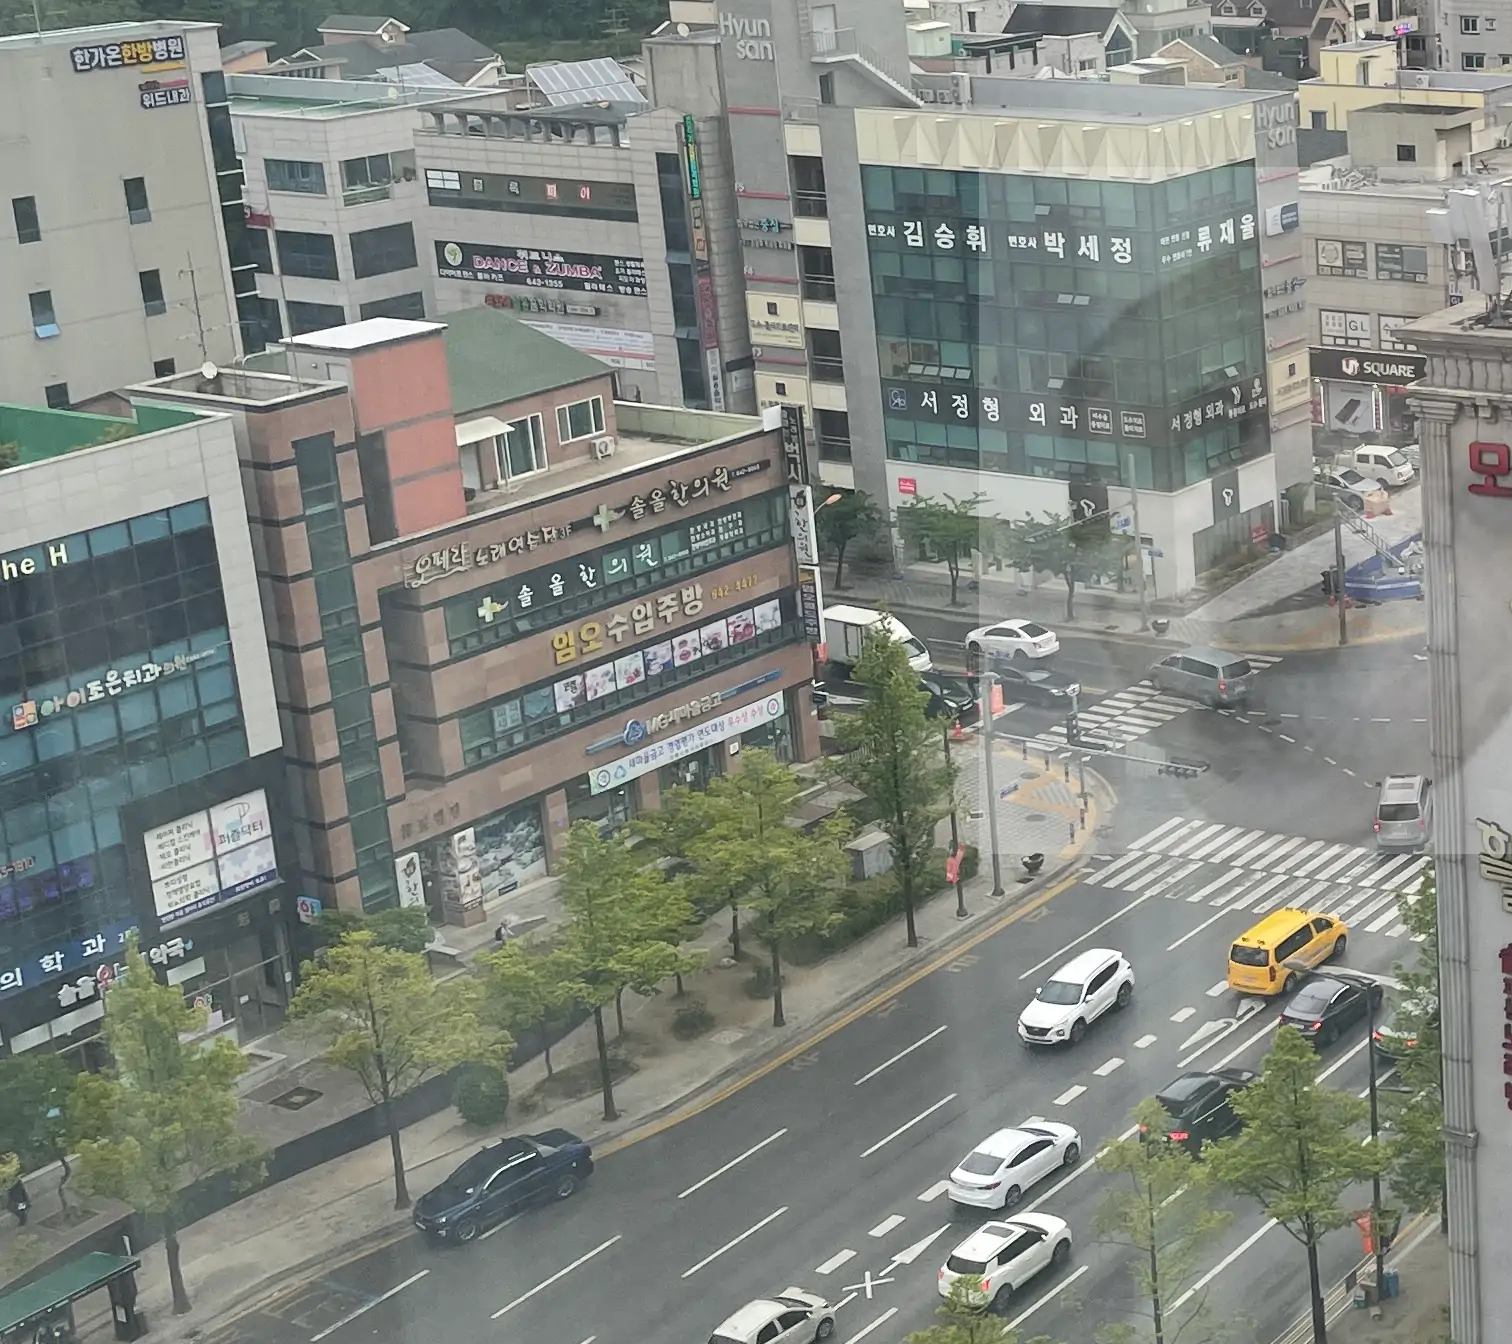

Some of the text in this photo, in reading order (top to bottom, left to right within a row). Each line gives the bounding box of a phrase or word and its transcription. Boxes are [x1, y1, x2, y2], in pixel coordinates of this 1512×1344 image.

[719, 12, 771, 40] Hyun
[73, 37, 184, 71] 한가온한방병원
[736, 40, 774, 61] san
[142, 87, 191, 108] 위드내과
[1256, 102, 1296, 129] Hyun
[1267, 126, 1297, 148] san
[867, 220, 987, 253] 변호사 김승휘
[1008, 232, 1132, 264] 변호사 박세정
[472, 254, 529, 274] DANCE
[544, 261, 604, 281] ZUMBA
[1363, 361, 1416, 378] SQUARE
[629, 466, 732, 520] 솔올한의원
[0, 542, 68, 581] he H
[413, 541, 471, 588] 오페라
[475, 526, 558, 567] 노래연습장
[517, 543, 659, 608] 솔올한의원
[218, 819, 264, 845] 퍼즐닥터
